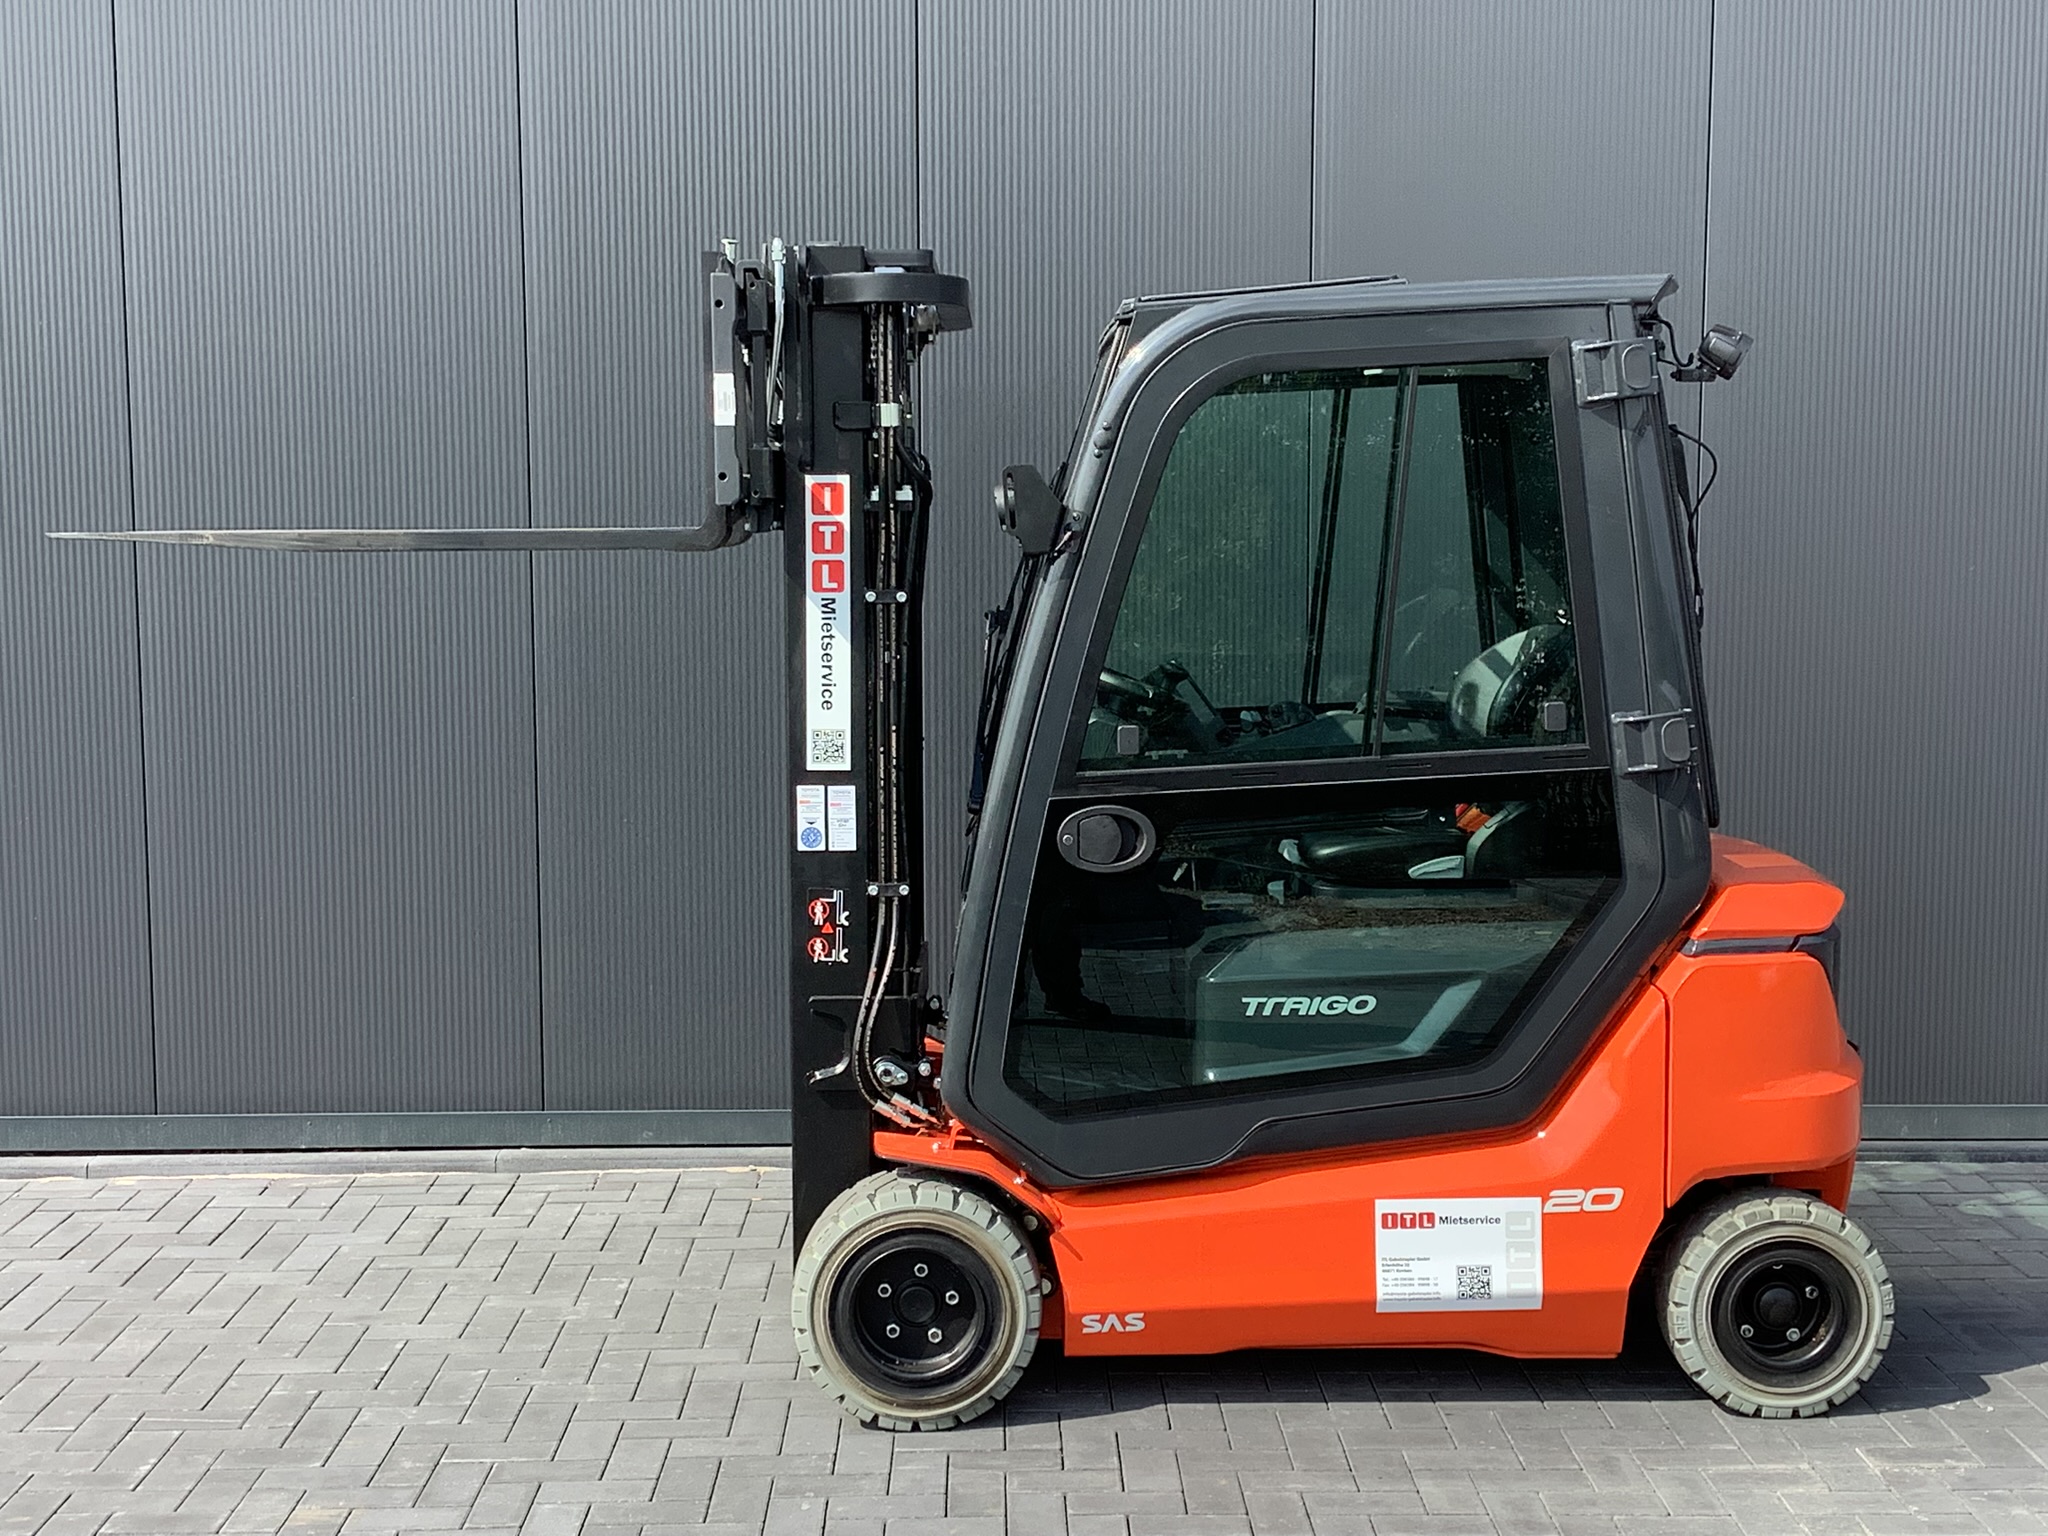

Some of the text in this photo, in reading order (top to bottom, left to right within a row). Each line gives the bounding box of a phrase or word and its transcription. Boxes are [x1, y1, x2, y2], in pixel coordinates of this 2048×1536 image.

[816, 485, 840, 711] ITL Mietservice
[1542, 1187, 1625, 1214] 20
[1385, 1213, 1502, 1228] ITL Mietservice
[1081, 1312, 1146, 1334] SAS
